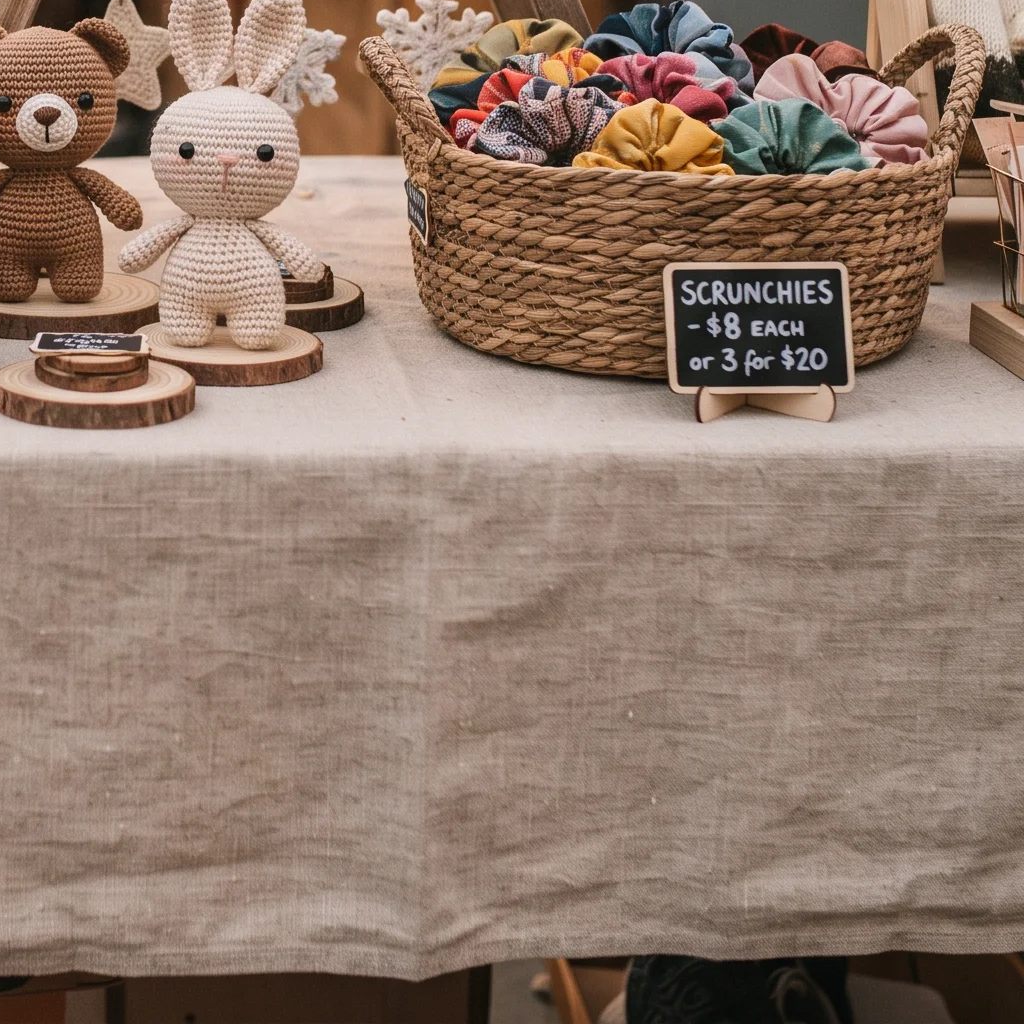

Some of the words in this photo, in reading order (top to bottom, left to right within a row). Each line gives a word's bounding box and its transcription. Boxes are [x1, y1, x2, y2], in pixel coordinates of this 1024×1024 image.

[680, 279, 834, 305] SCRUNCHIES
[750, 320, 805, 337] EACH
[689, 356, 715, 371] or
[721, 348, 738, 372] 3
[743, 349, 776, 377] for
[780, 344, 828, 371] $20
